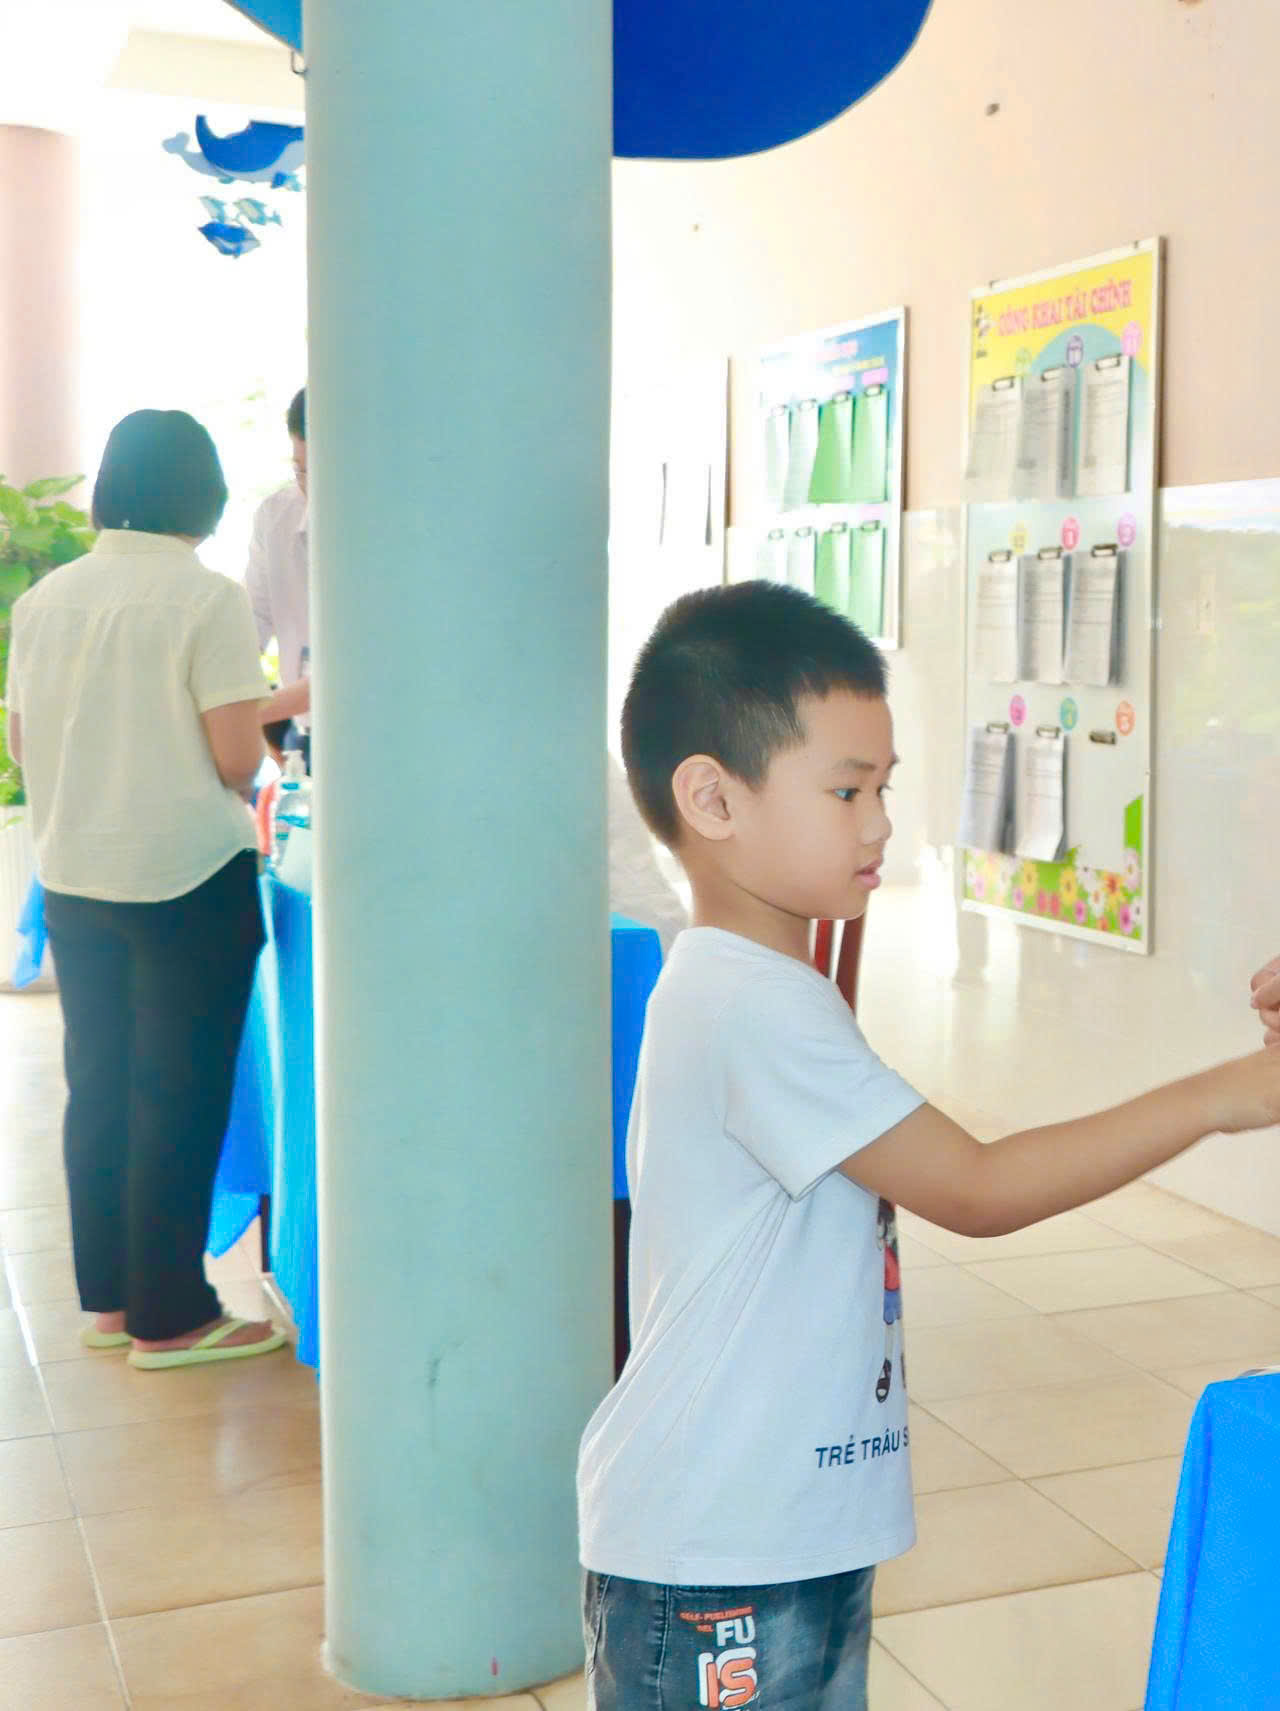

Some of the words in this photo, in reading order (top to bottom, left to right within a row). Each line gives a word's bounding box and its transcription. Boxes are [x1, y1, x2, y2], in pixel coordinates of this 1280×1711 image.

[815, 1434, 855, 1468] TRẺ
[861, 1427, 900, 1460] TRÂU
[716, 1615, 755, 1647] FU
[698, 1647, 758, 1710] IS
